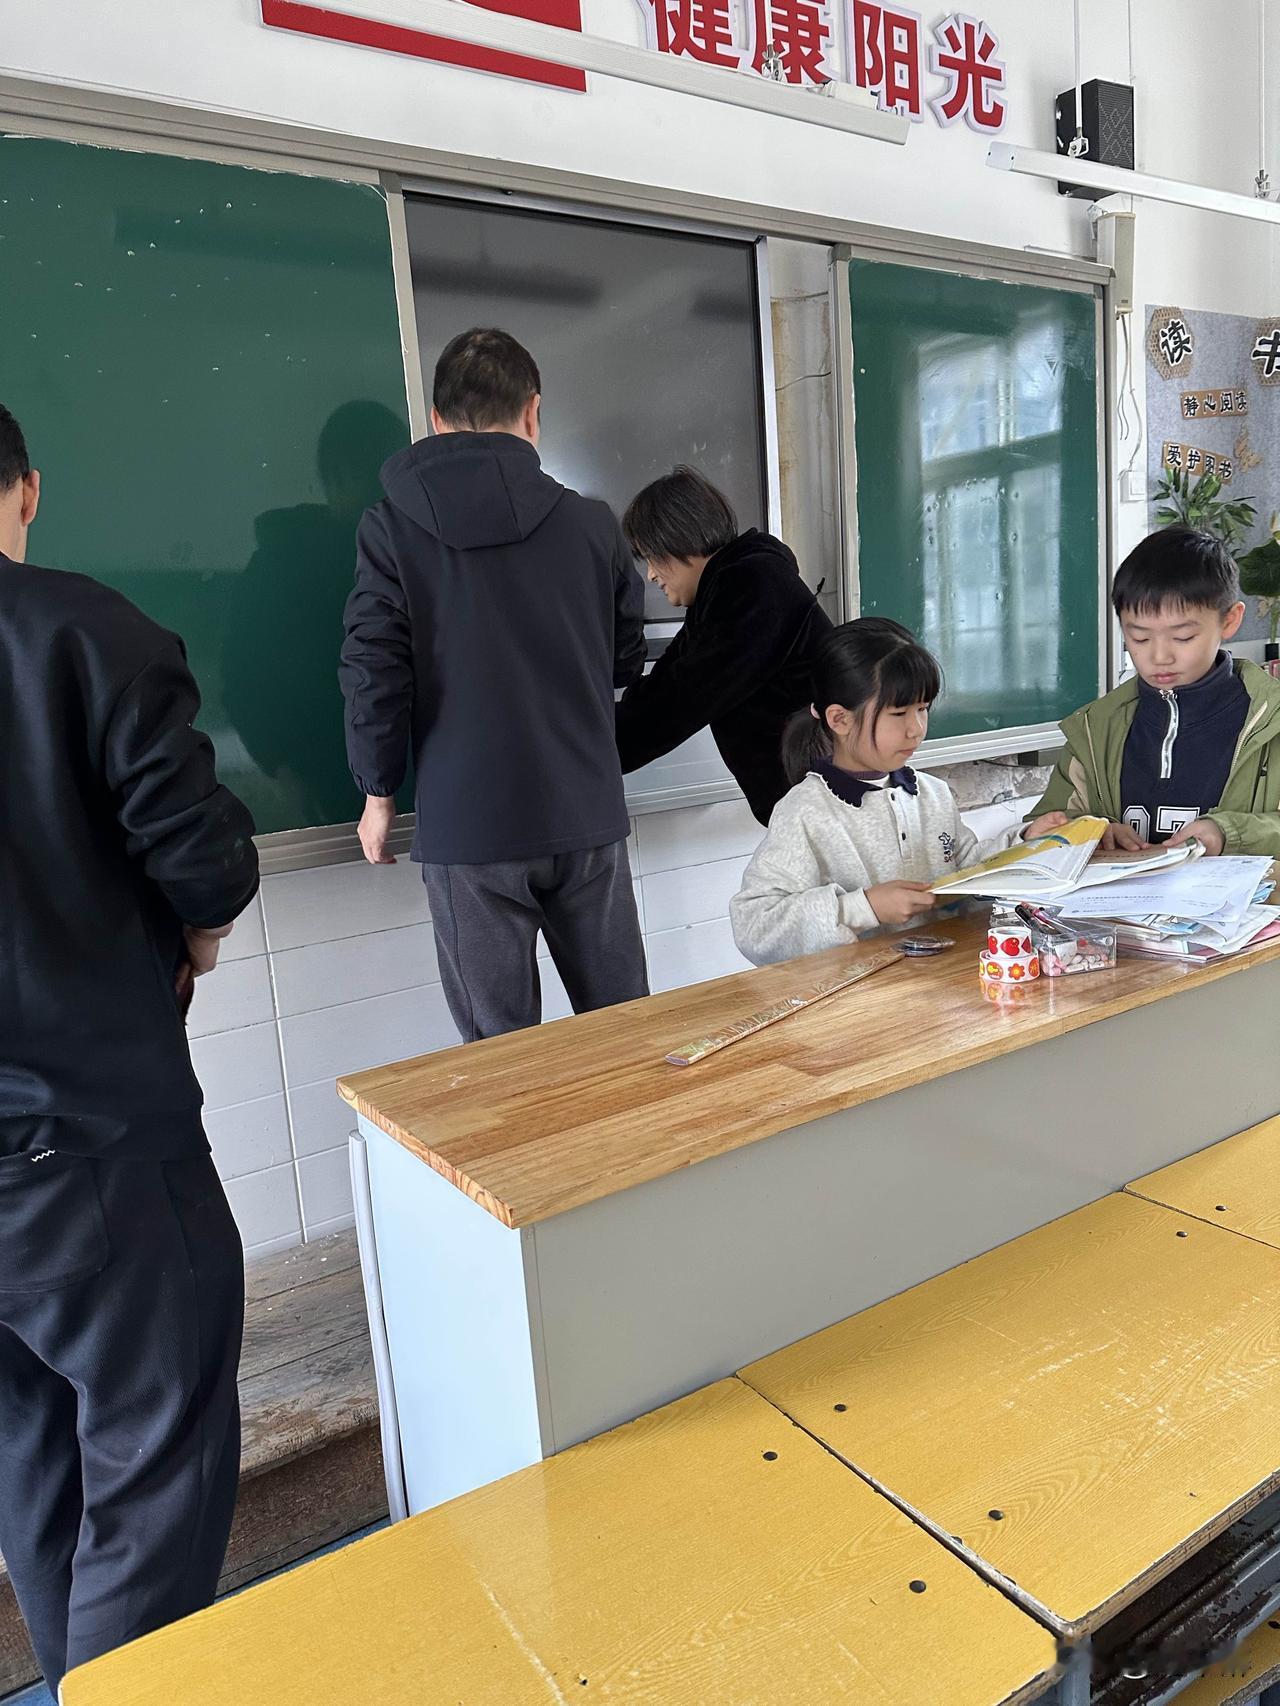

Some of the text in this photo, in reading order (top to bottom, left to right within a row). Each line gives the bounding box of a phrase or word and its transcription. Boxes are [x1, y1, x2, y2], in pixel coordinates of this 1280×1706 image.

[650, 0, 1004, 128] 健康阳光
[1161, 320, 1192, 364] 读
[1183, 391, 1247, 417] 静心阅读
[1167, 444, 1232, 479] 爱护图书
[1122, 805, 1200, 845] 07
